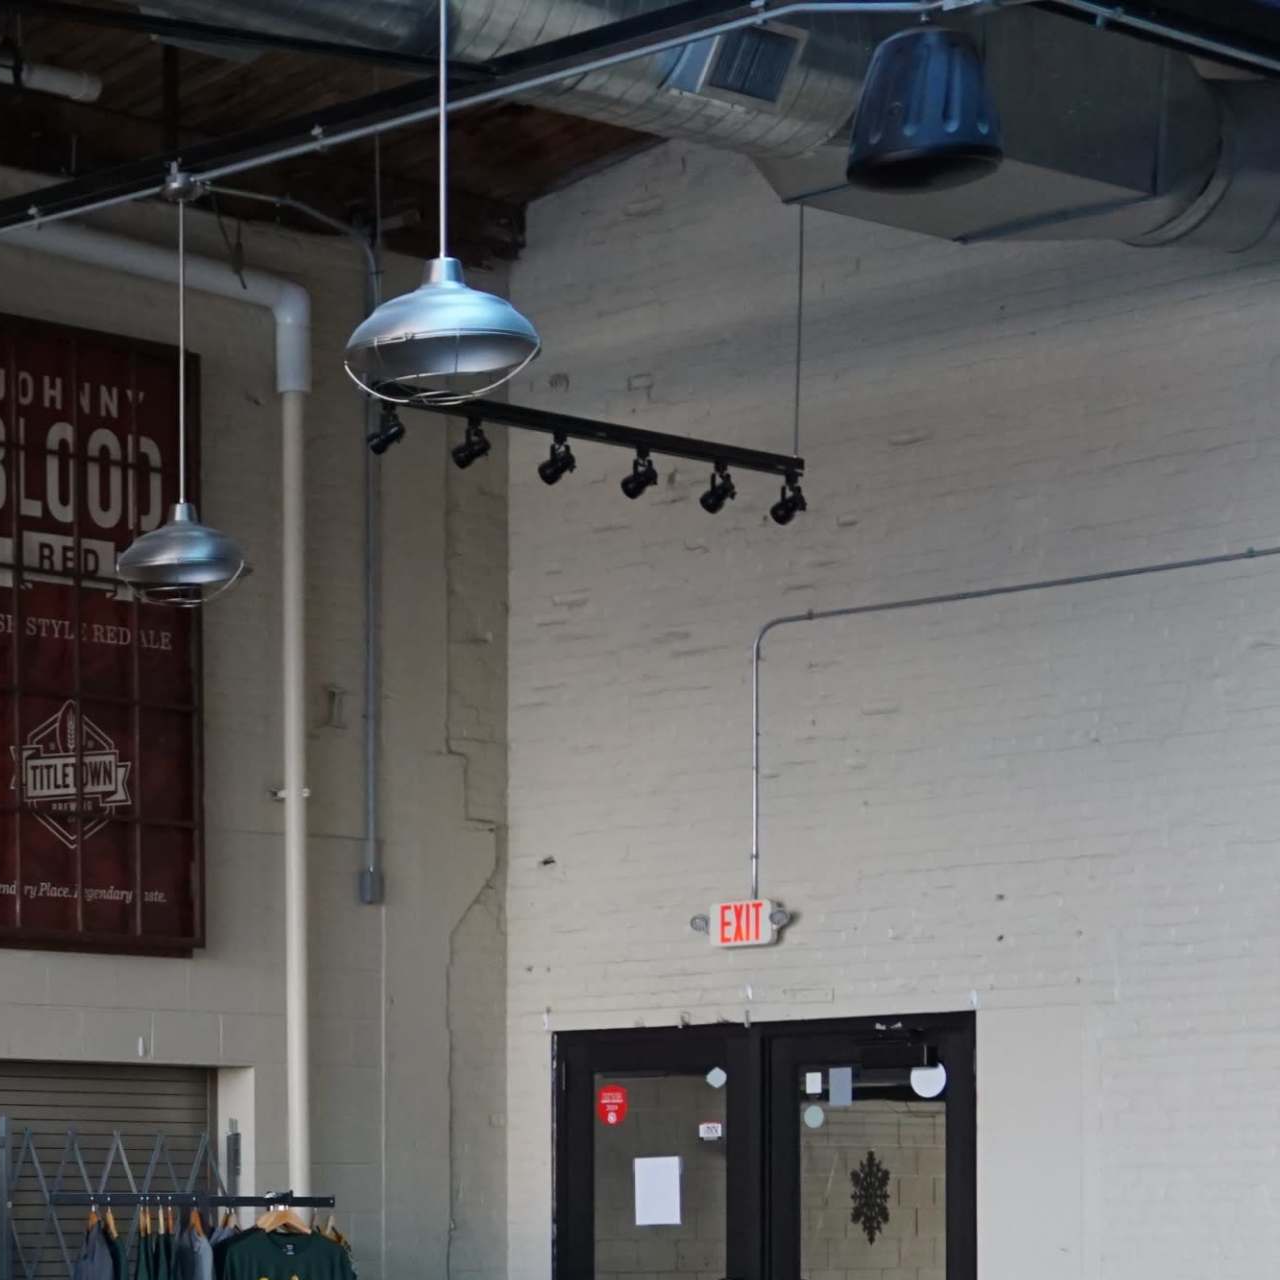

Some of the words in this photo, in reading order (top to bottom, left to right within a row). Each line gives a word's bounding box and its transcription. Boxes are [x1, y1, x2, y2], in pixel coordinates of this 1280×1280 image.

[40, 543, 100, 575] RED
[92, 622, 132, 647] RED
[720, 902, 763, 944] EXIT
